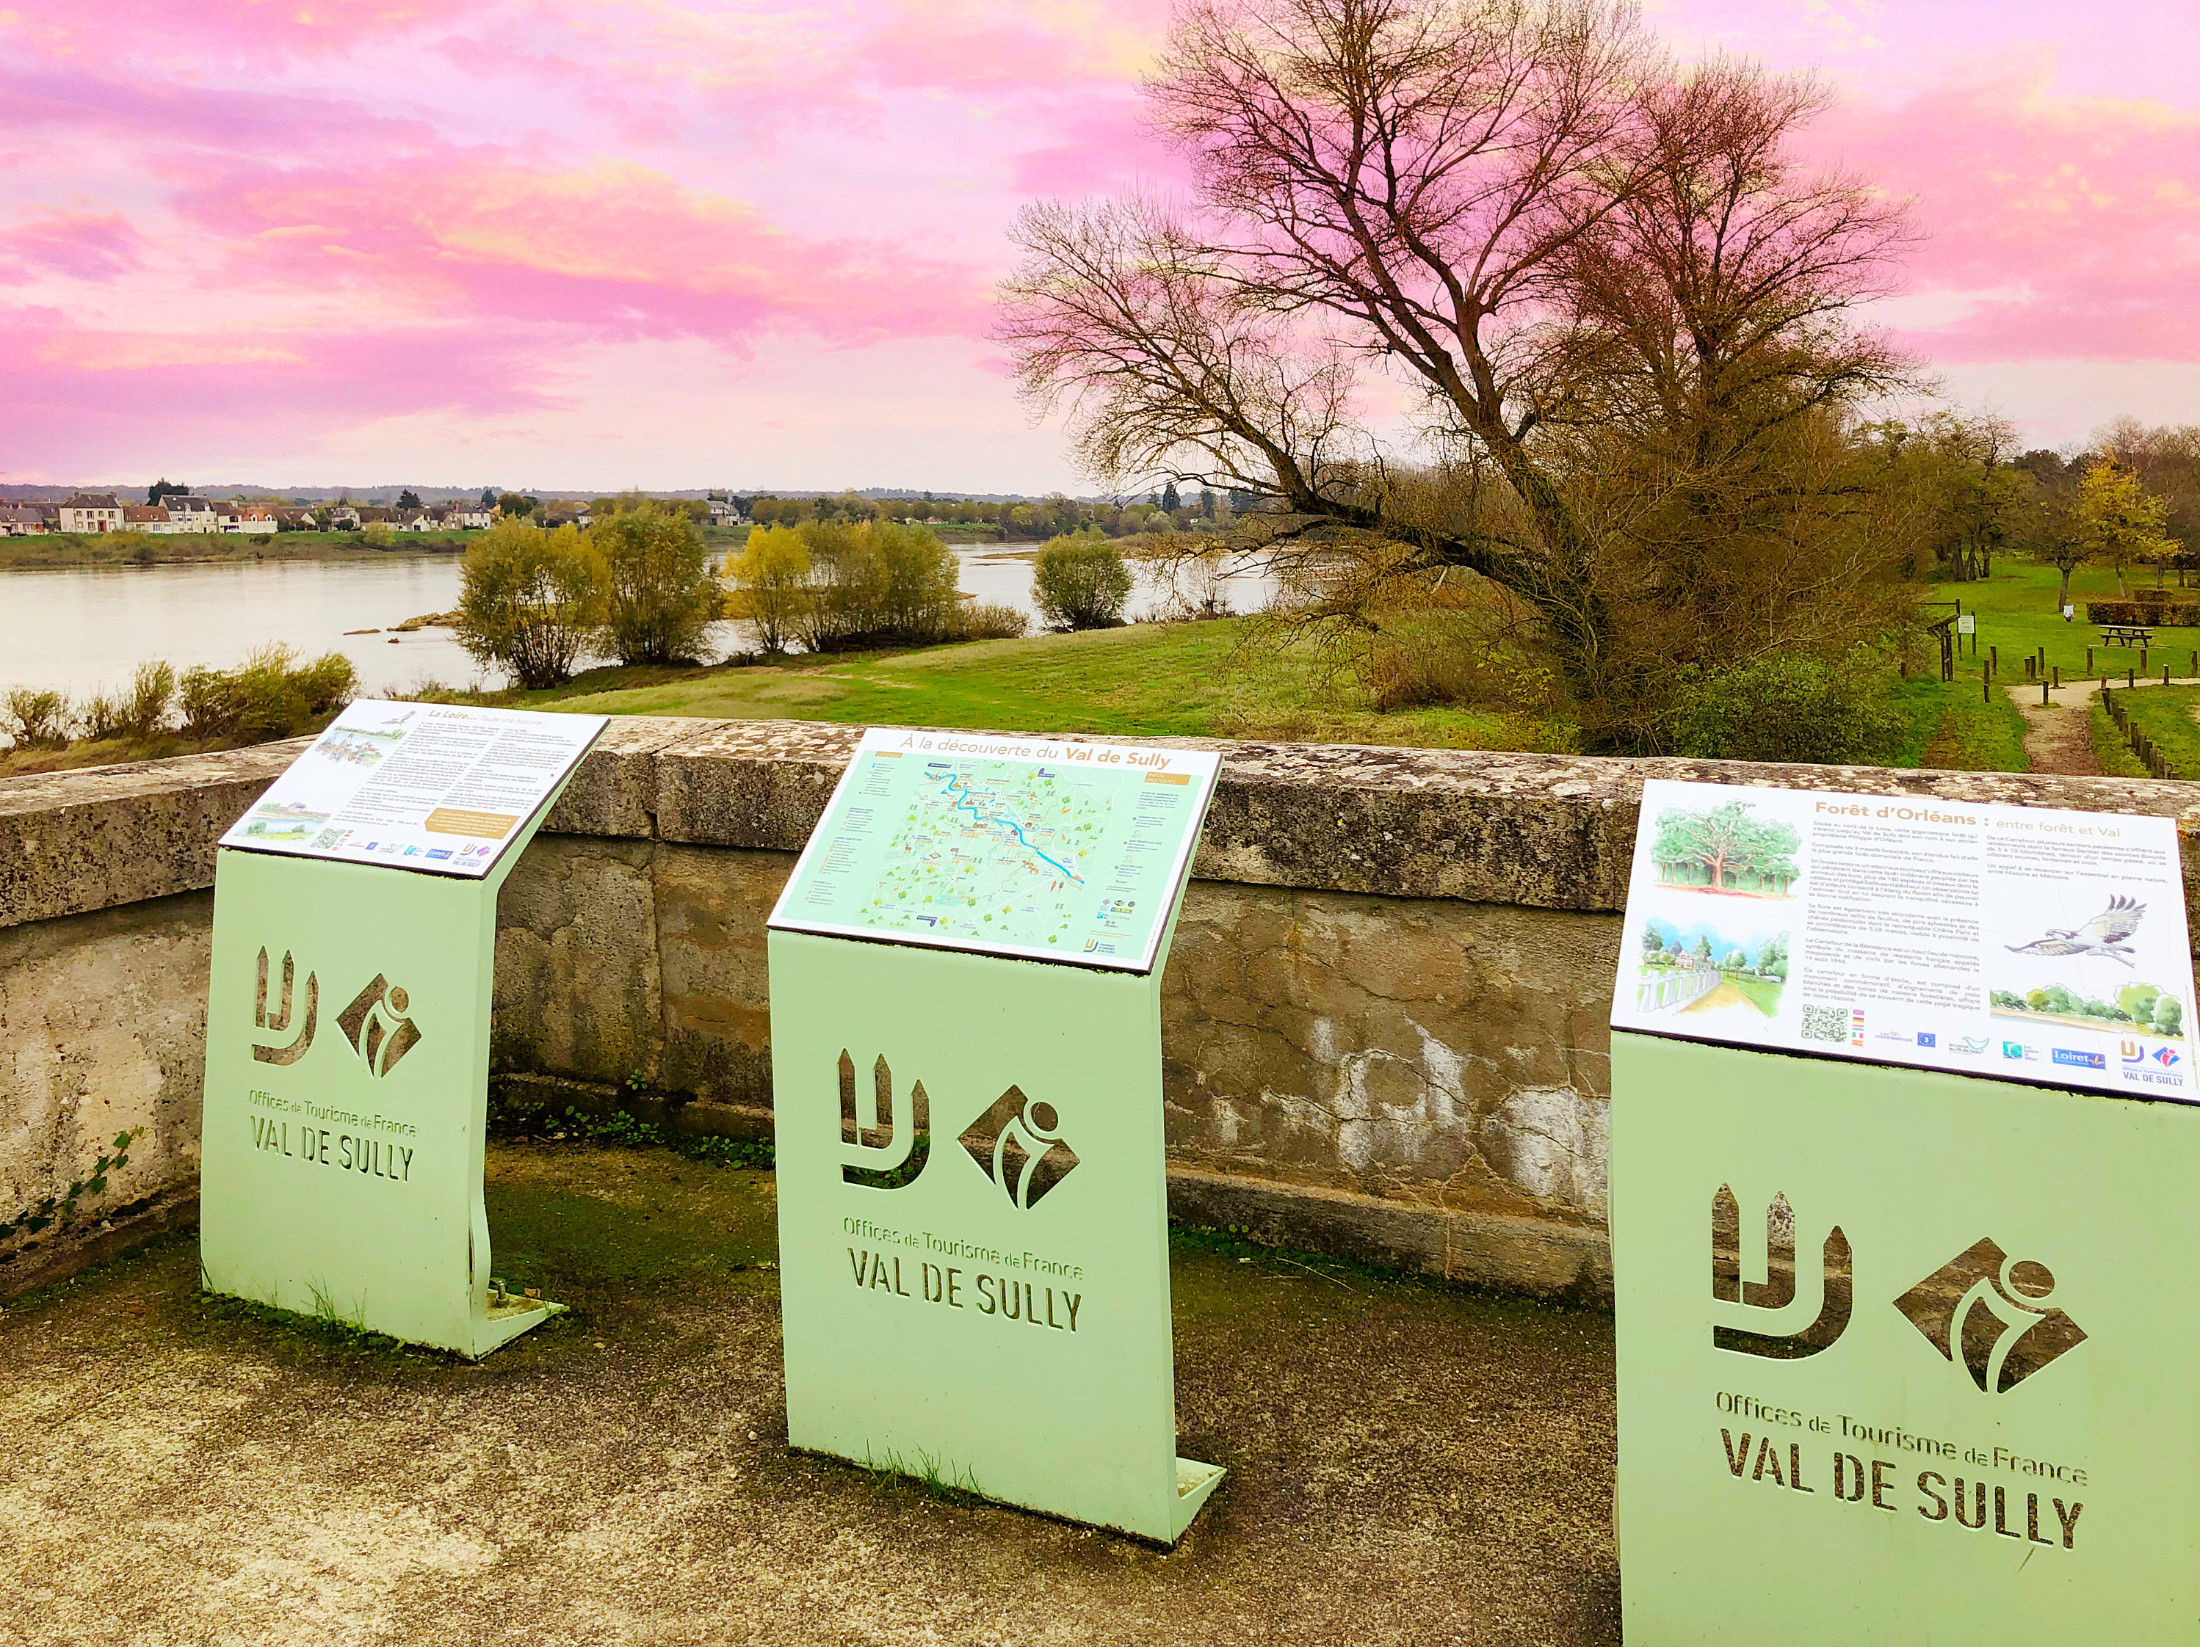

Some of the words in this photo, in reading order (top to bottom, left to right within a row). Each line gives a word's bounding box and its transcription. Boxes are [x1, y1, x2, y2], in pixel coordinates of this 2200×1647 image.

[428, 709, 441, 717] La
[442, 710, 477, 720] Loire...
[900, 732, 917, 748] À
[919, 737, 934, 749] la
[938, 738, 1032, 759] découverte
[1037, 745, 1059, 759] du
[1065, 747, 1093, 762] Val
[1097, 750, 1121, 764] de
[1126, 752, 1173, 771] Sully
[1815, 801, 1869, 817] Forêt
[1876, 806, 1977, 826] d'Orléans
[1996, 820, 2034, 831] entre
[2039, 821, 2074, 834] forêt
[2079, 825, 2093, 835] et
[2098, 826, 2121, 837] Val
[2054, 1050, 2089, 1063] Loiret
[2123, 1071, 2140, 1080] VAL
[2142, 1074, 2154, 1082] DE
[2156, 1076, 2183, 1086] SULLY
[250, 1089, 289, 1112] Offices
[291, 1101, 301, 1113] de
[304, 1100, 358, 1127] Tourisme
[361, 1115, 372, 1128] de
[374, 1114, 417, 1138] France
[250, 1116, 292, 1157] VAL
[302, 1127, 330, 1166] DE
[338, 1134, 413, 1182] SULLY
[843, 1217, 900, 1244] Offices
[905, 1234, 919, 1248] de
[922, 1232, 1000, 1265] Tourisme
[1005, 1253, 1021, 1268] de
[1023, 1251, 1083, 1281] France
[848, 1247, 910, 1297] VAL
[922, 1262, 964, 1308] DE
[976, 1274, 1082, 1333] SULLY
[1716, 1390, 1802, 1428] Offices
[1808, 1415, 1831, 1434] de
[1836, 1414, 1957, 1461] Tourisme
[1964, 1447, 1989, 1467] de
[1993, 1446, 2089, 1487] France
[1720, 1428, 1815, 1494] VAL
[1834, 1452, 1898, 1512] DE
[1917, 1471, 2084, 1550] SULLY
